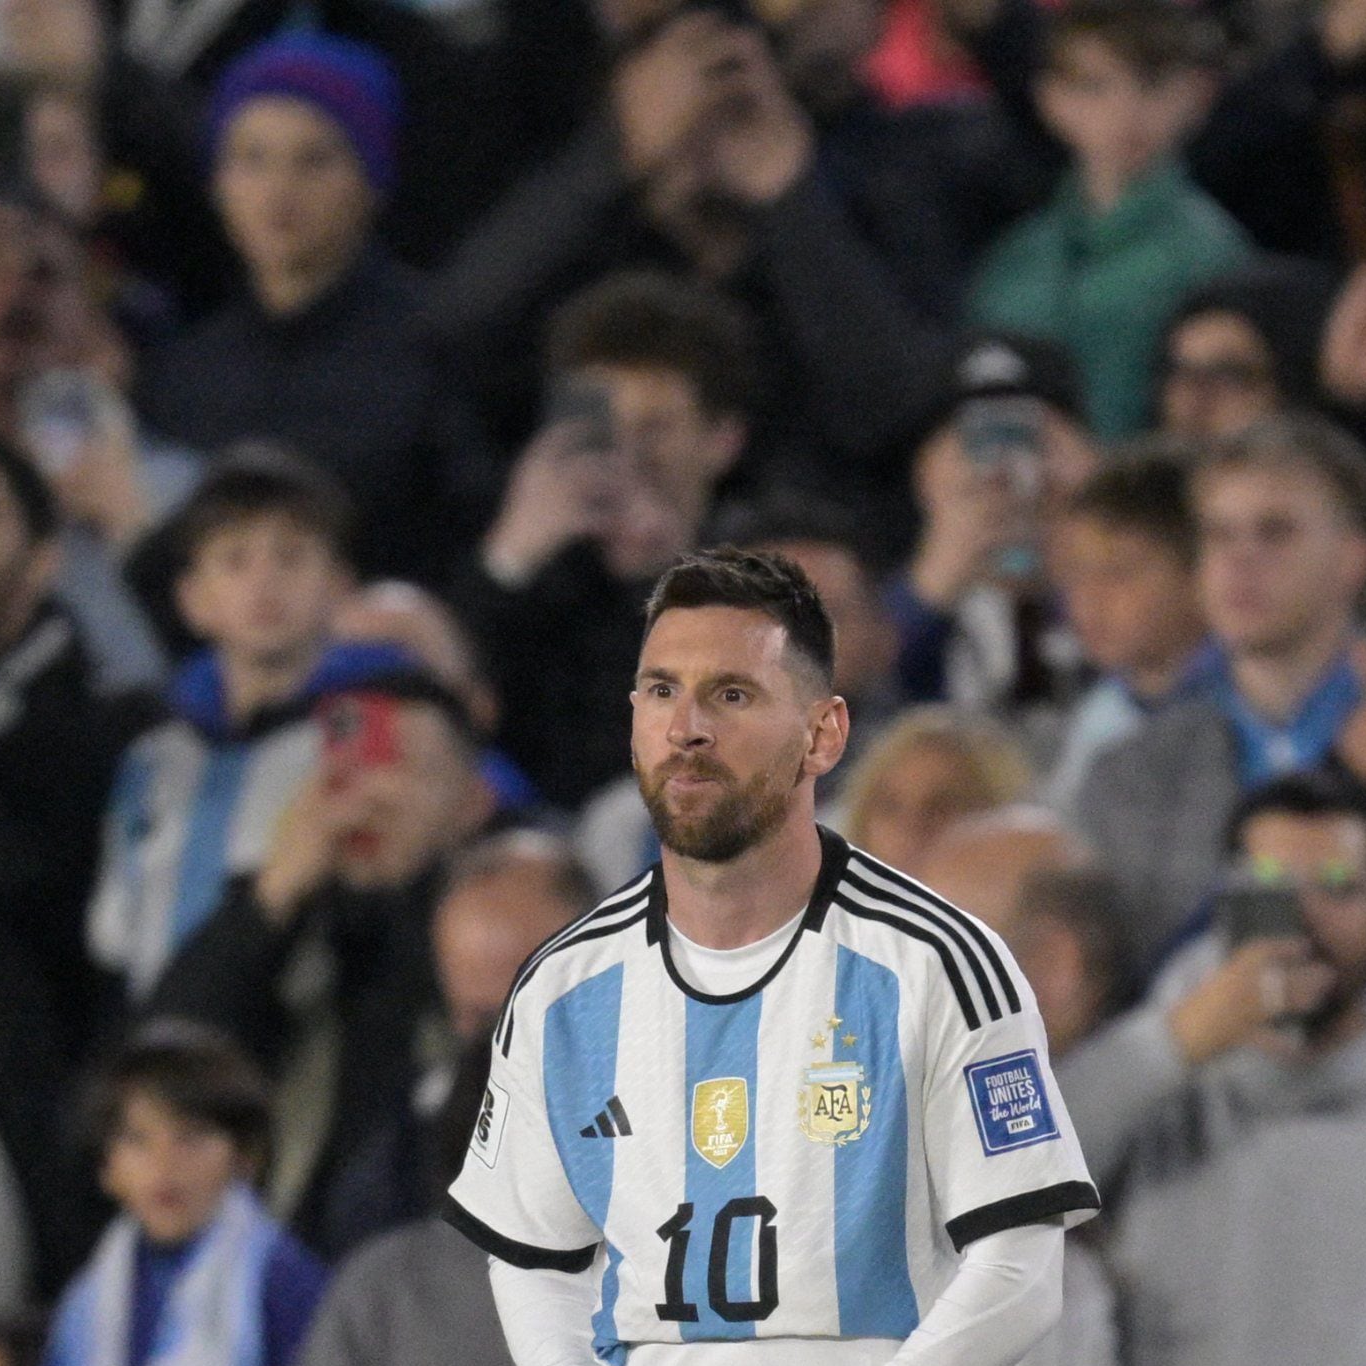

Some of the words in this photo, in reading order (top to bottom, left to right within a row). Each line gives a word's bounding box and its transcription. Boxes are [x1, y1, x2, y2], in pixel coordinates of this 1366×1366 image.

[985, 1067, 1031, 1088] FOOTBALL
[814, 1084, 853, 1122] AFA
[988, 1080, 1035, 1105] UNITES
[989, 1105, 1010, 1122] the
[1009, 1095, 1042, 1117] World
[1010, 1120, 1031, 1131] FIFA
[708, 1133, 733, 1146] FIFA
[655, 1195, 780, 1322] 10
